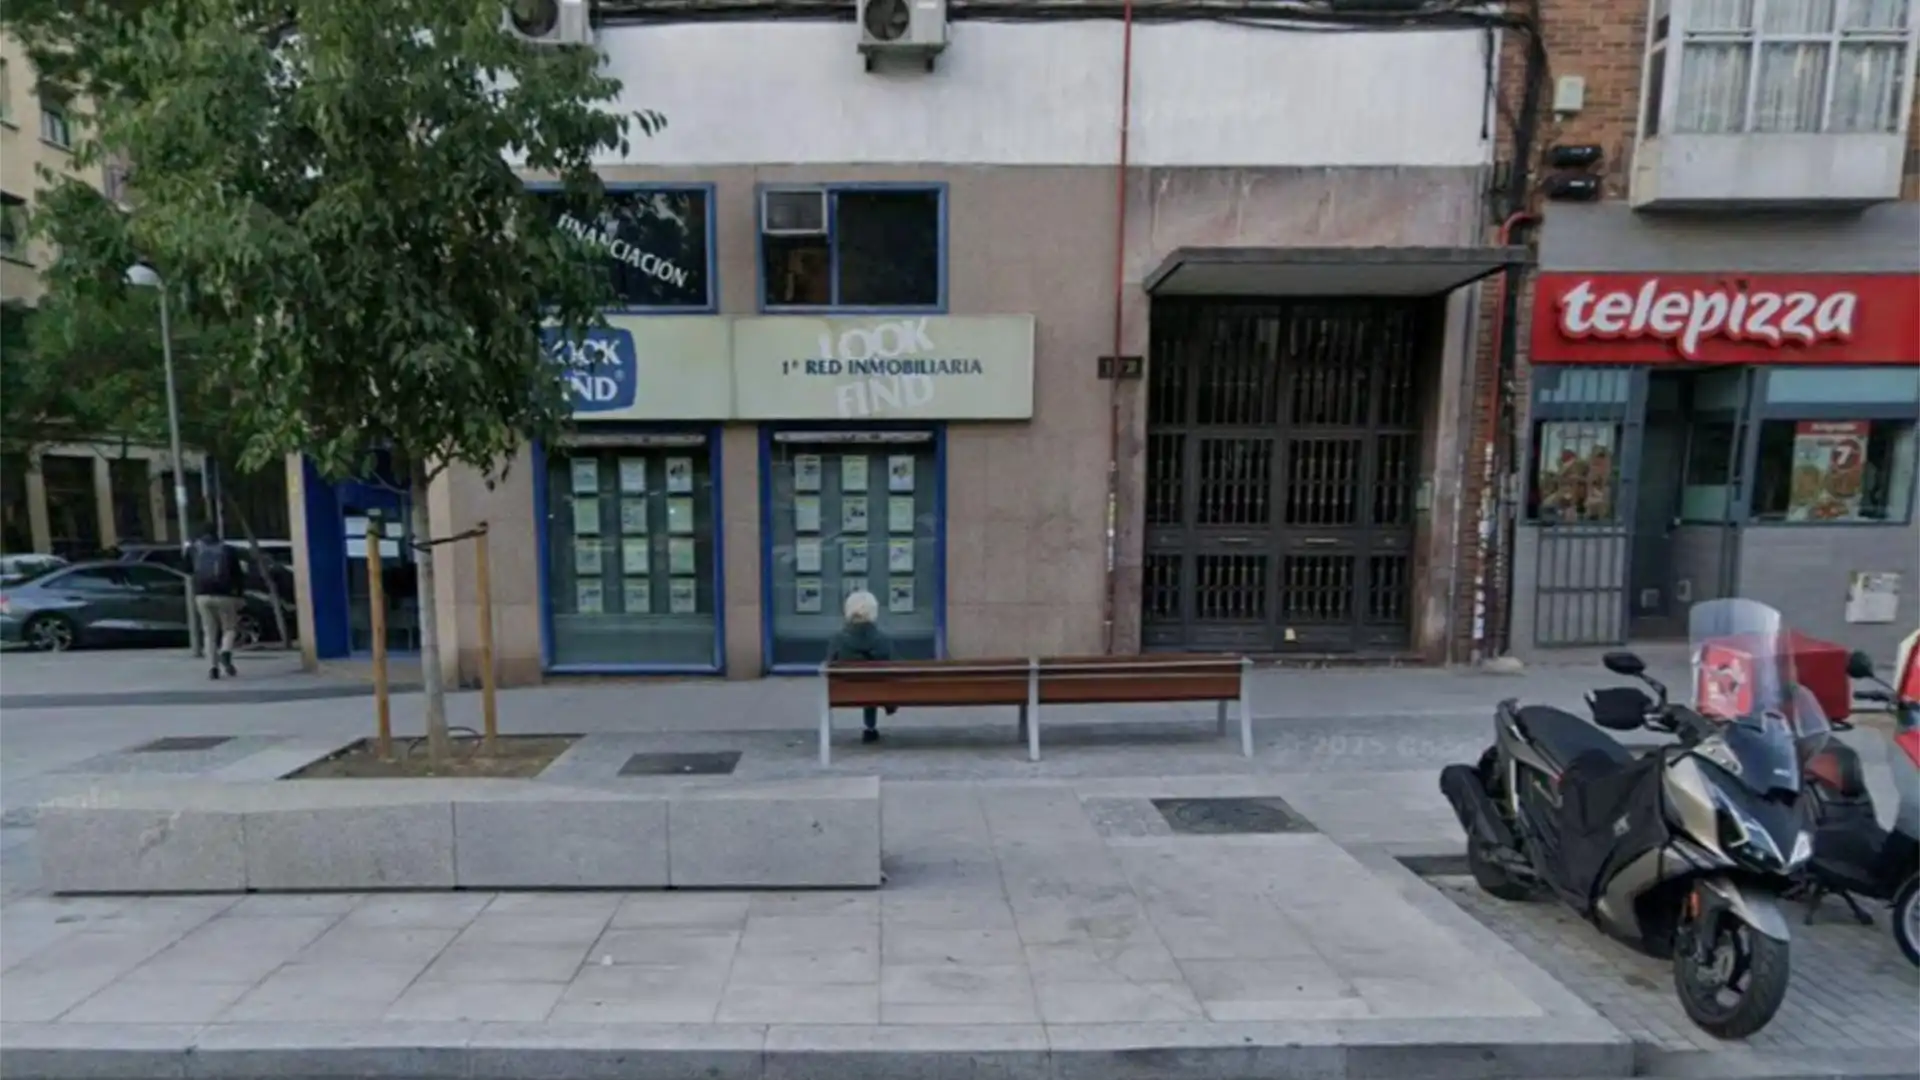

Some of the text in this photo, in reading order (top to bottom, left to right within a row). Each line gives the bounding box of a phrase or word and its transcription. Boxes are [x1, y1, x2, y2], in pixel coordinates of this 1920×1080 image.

[1561, 278, 1857, 354] telepizza
[804, 359, 843, 375] RED
[848, 358, 983, 375] INMOBILIARIA
